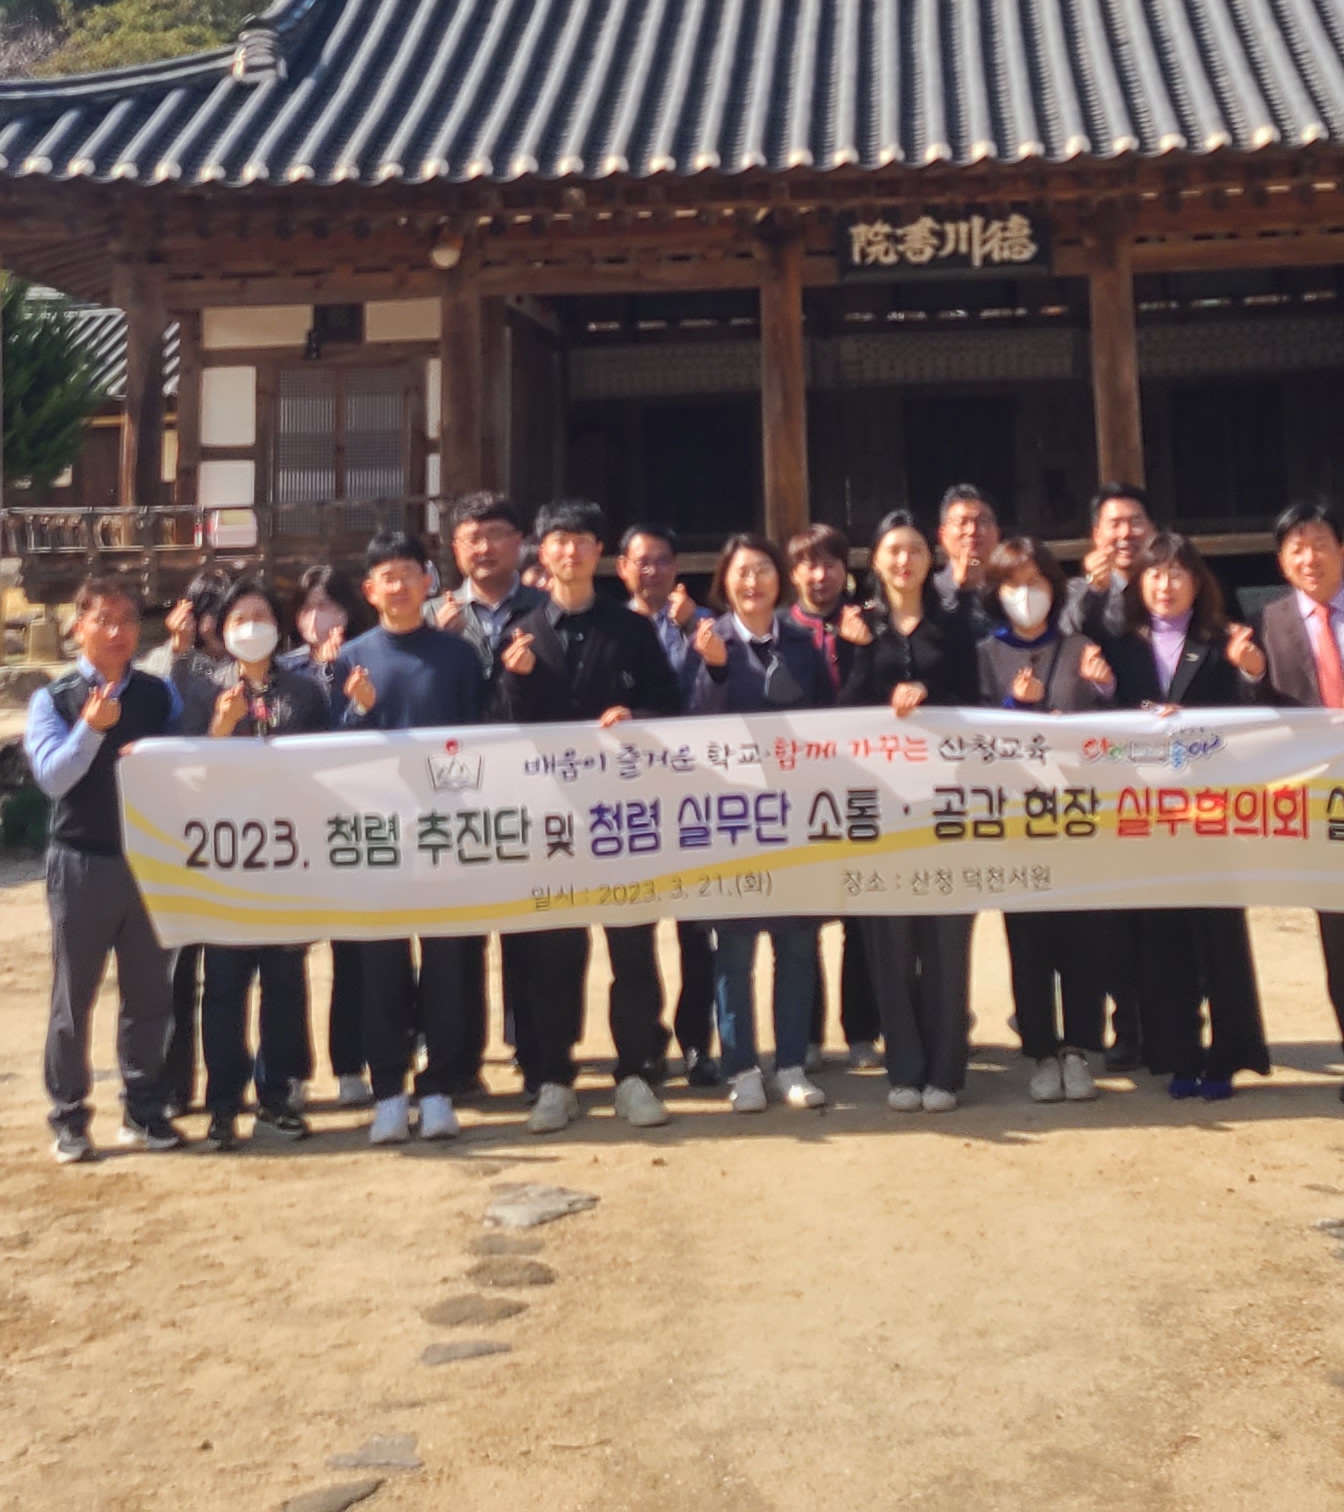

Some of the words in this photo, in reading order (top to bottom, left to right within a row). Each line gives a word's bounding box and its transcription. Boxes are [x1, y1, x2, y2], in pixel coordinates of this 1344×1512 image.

[524, 749, 607, 782] 배움이
[616, 742, 697, 779] 즐거운
[850, 735, 929, 764] 가꾸는
[938, 732, 1052, 763] 산청교육
[185, 820, 311, 870] 2023.
[326, 814, 402, 868] 청렴
[416, 806, 533, 865] 추진단
[544, 813, 575, 859] 및
[588, 800, 663, 859] 청렴
[678, 789, 793, 847] 실무단
[807, 786, 882, 842] 소통
[931, 787, 1008, 840] 공감
[1023, 787, 1100, 838] 현장
[1115, 786, 1309, 840] 실무협의회
[531, 885, 576, 911] 일시
[598, 879, 662, 906] 2023.
[842, 869, 887, 895] 장소
[909, 869, 954, 896] 산청
[961, 865, 1053, 894] 덕천서원
